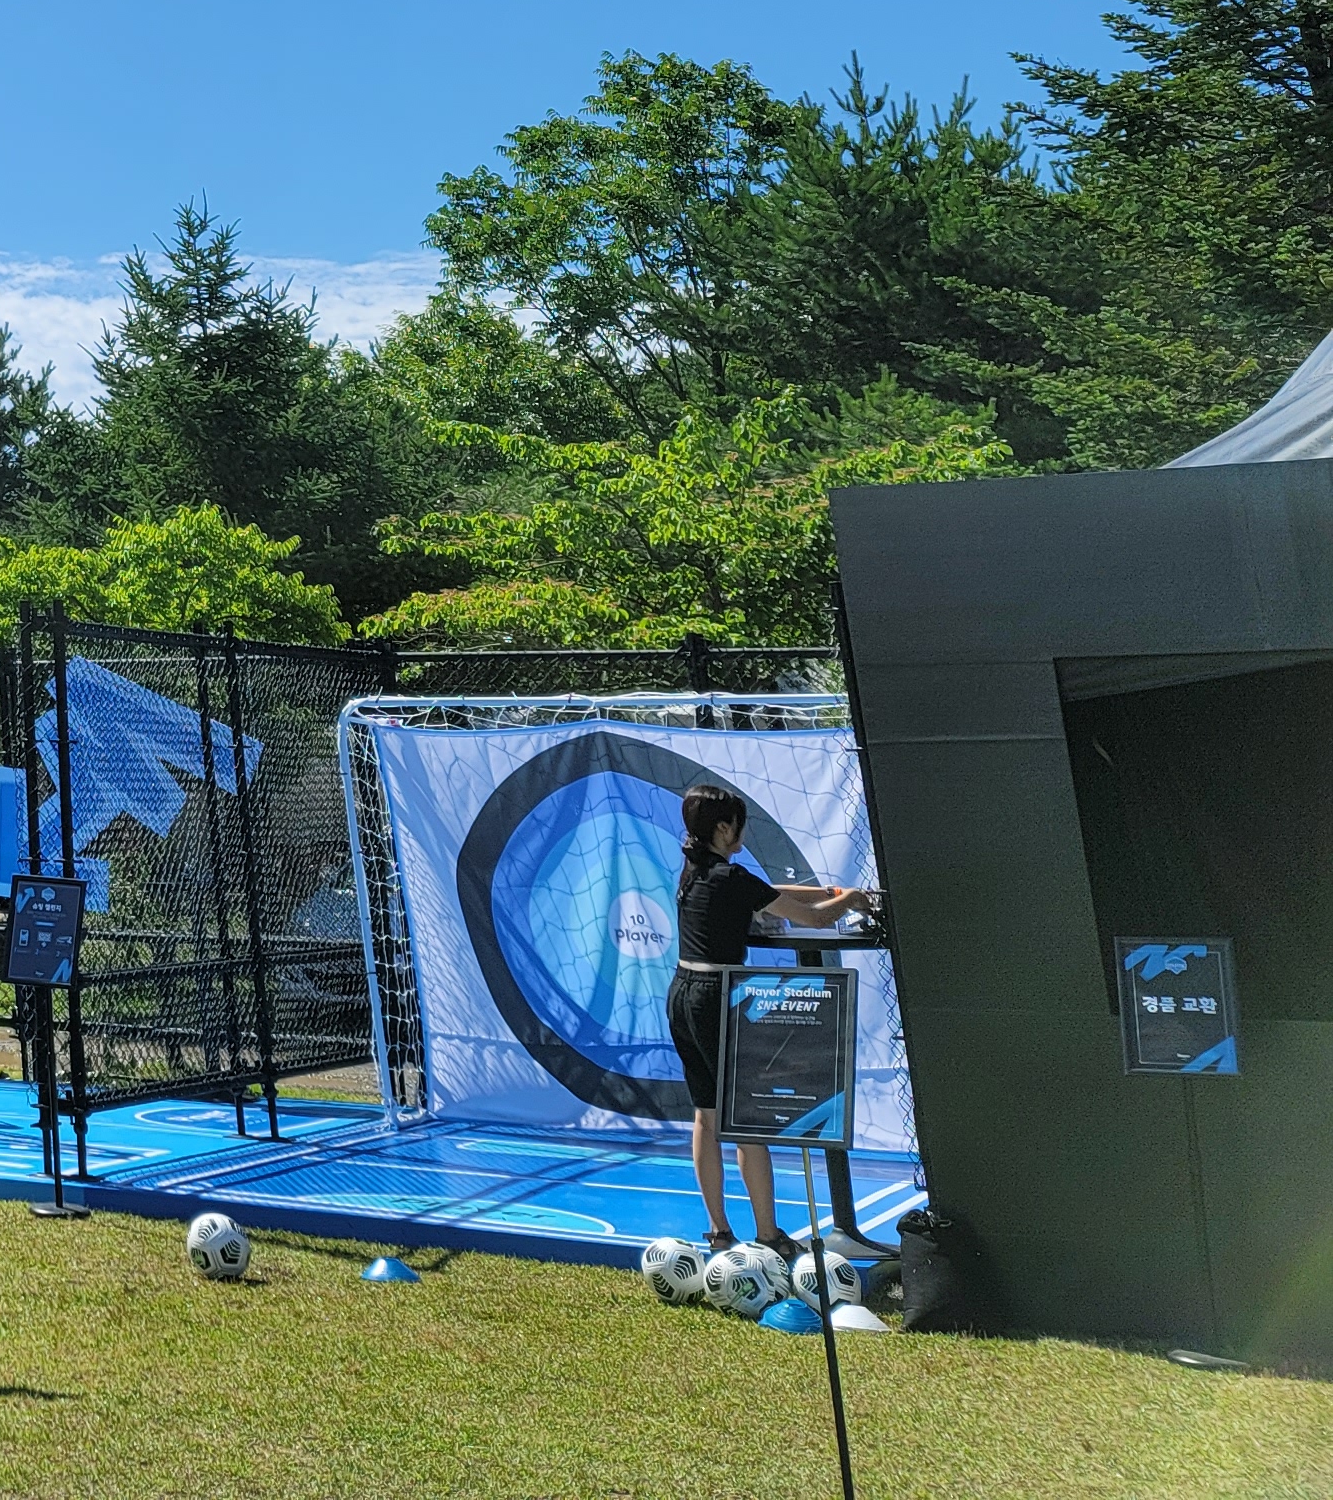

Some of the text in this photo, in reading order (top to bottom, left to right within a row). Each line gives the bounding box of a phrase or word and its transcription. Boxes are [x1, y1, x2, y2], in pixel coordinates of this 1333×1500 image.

[785, 865, 796, 879] 2
[630, 914, 645, 926] 10
[744, 986, 832, 999] Player Stadium
[756, 1000, 821, 1012] SNS EVENT
[1141, 995, 1218, 1015] 경품 교환
